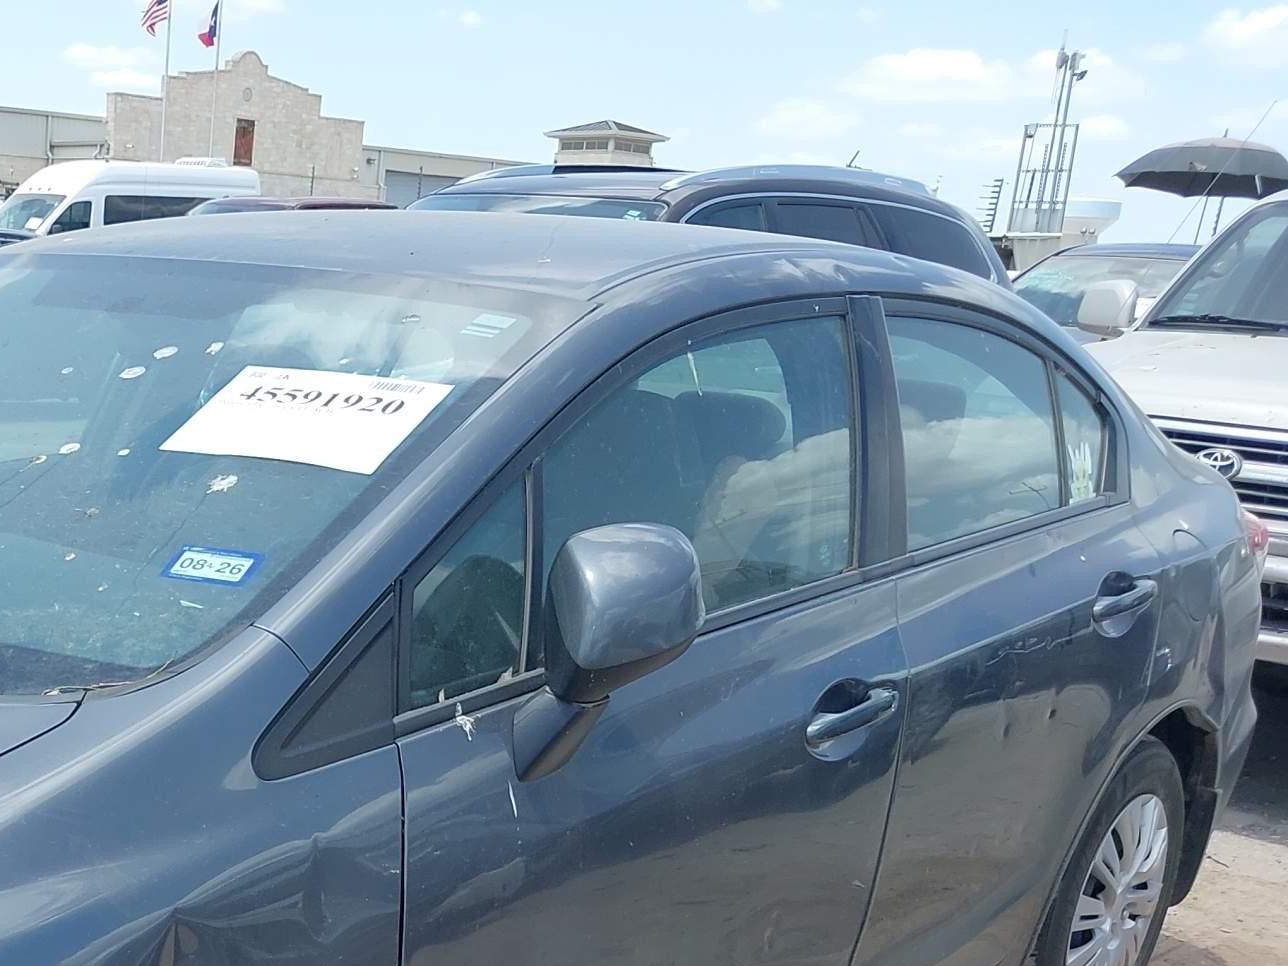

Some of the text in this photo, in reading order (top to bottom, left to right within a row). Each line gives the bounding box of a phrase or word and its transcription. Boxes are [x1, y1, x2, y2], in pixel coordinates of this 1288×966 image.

[239, 386, 405, 415] 45591920
[179, 557, 245, 575] 08 26
